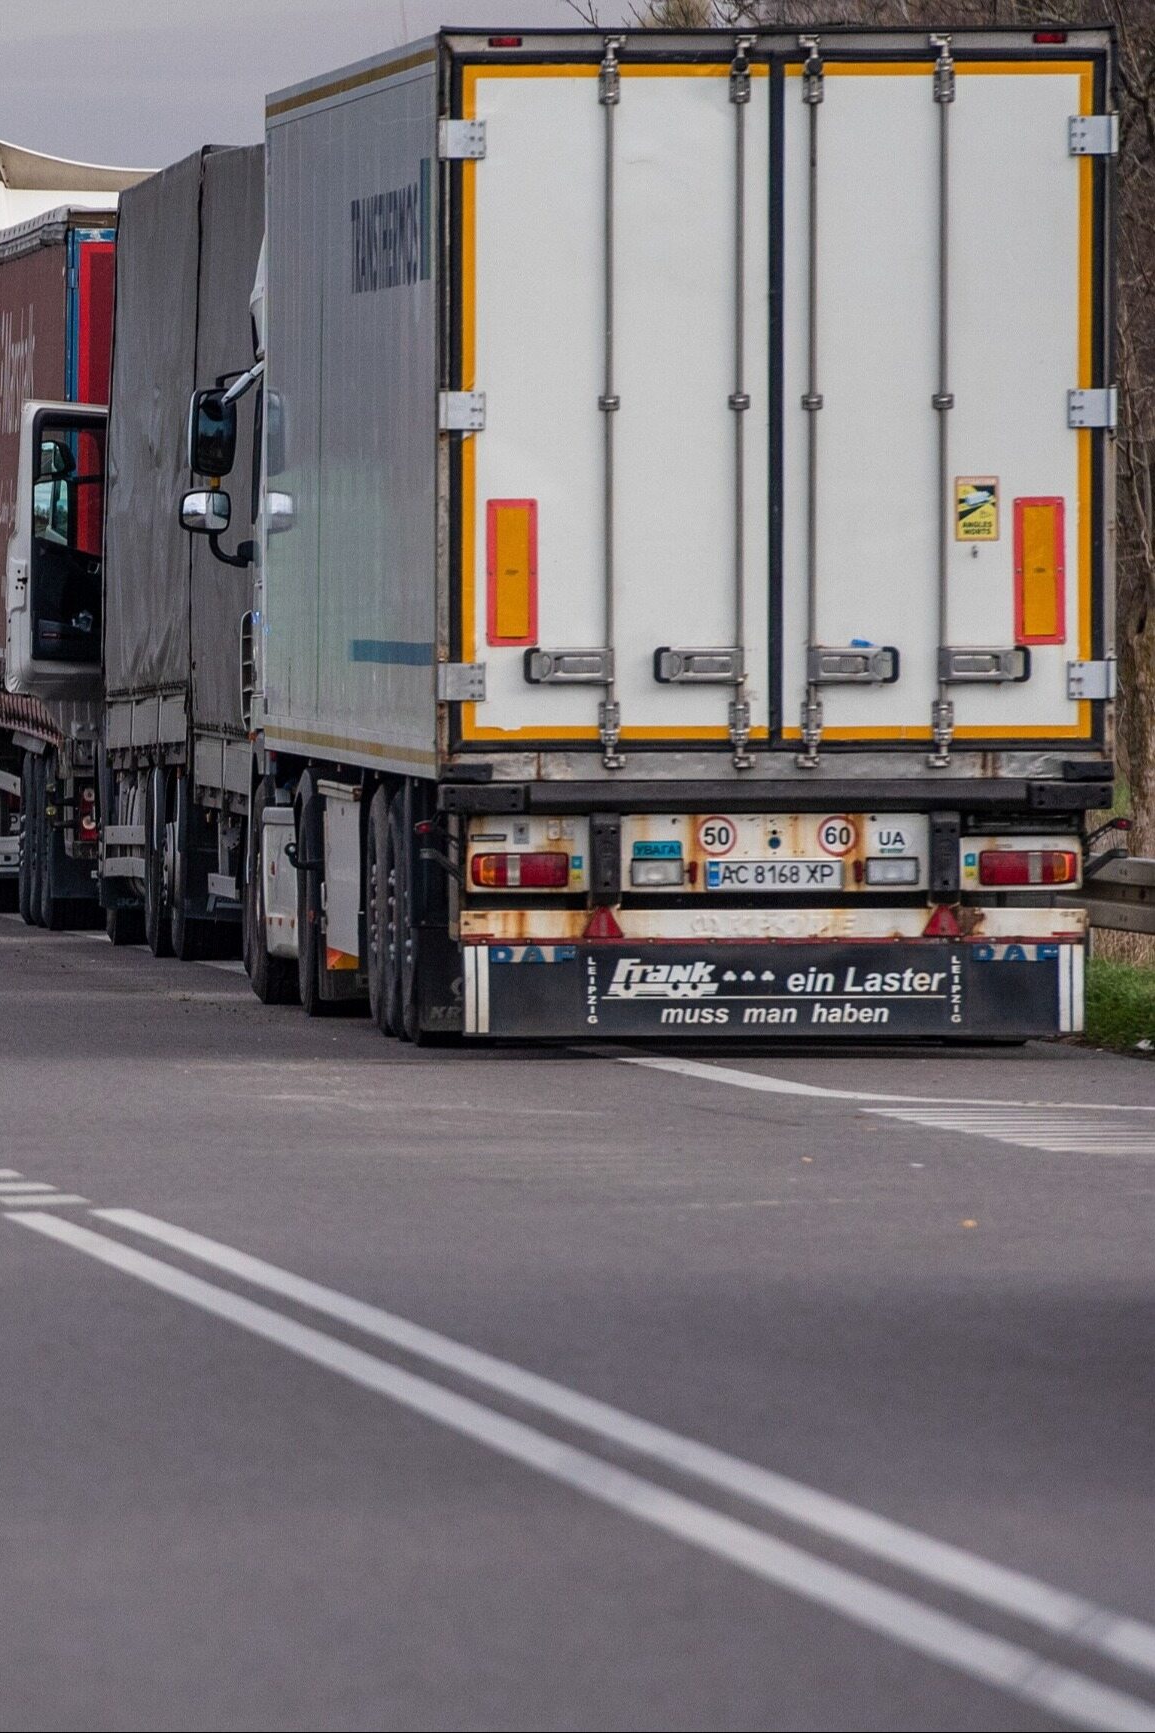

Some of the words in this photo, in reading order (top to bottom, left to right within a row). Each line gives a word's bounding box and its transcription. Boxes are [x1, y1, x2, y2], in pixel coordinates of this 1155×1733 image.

[703, 827, 730, 845] 50
[825, 827, 851, 845] 60
[879, 831, 906, 846] UA
[721, 865, 748, 884] AC
[754, 865, 801, 884] 8168
[806, 864, 834, 884] XP
[587, 956, 598, 1024] LEIPZIG
[787, 967, 834, 992] ein
[843, 967, 947, 993] Laster
[950, 955, 962, 1023] LEIPZIG
[661, 1007, 729, 1024] muss
[743, 1007, 797, 1023] man
[811, 1003, 889, 1023] haben
